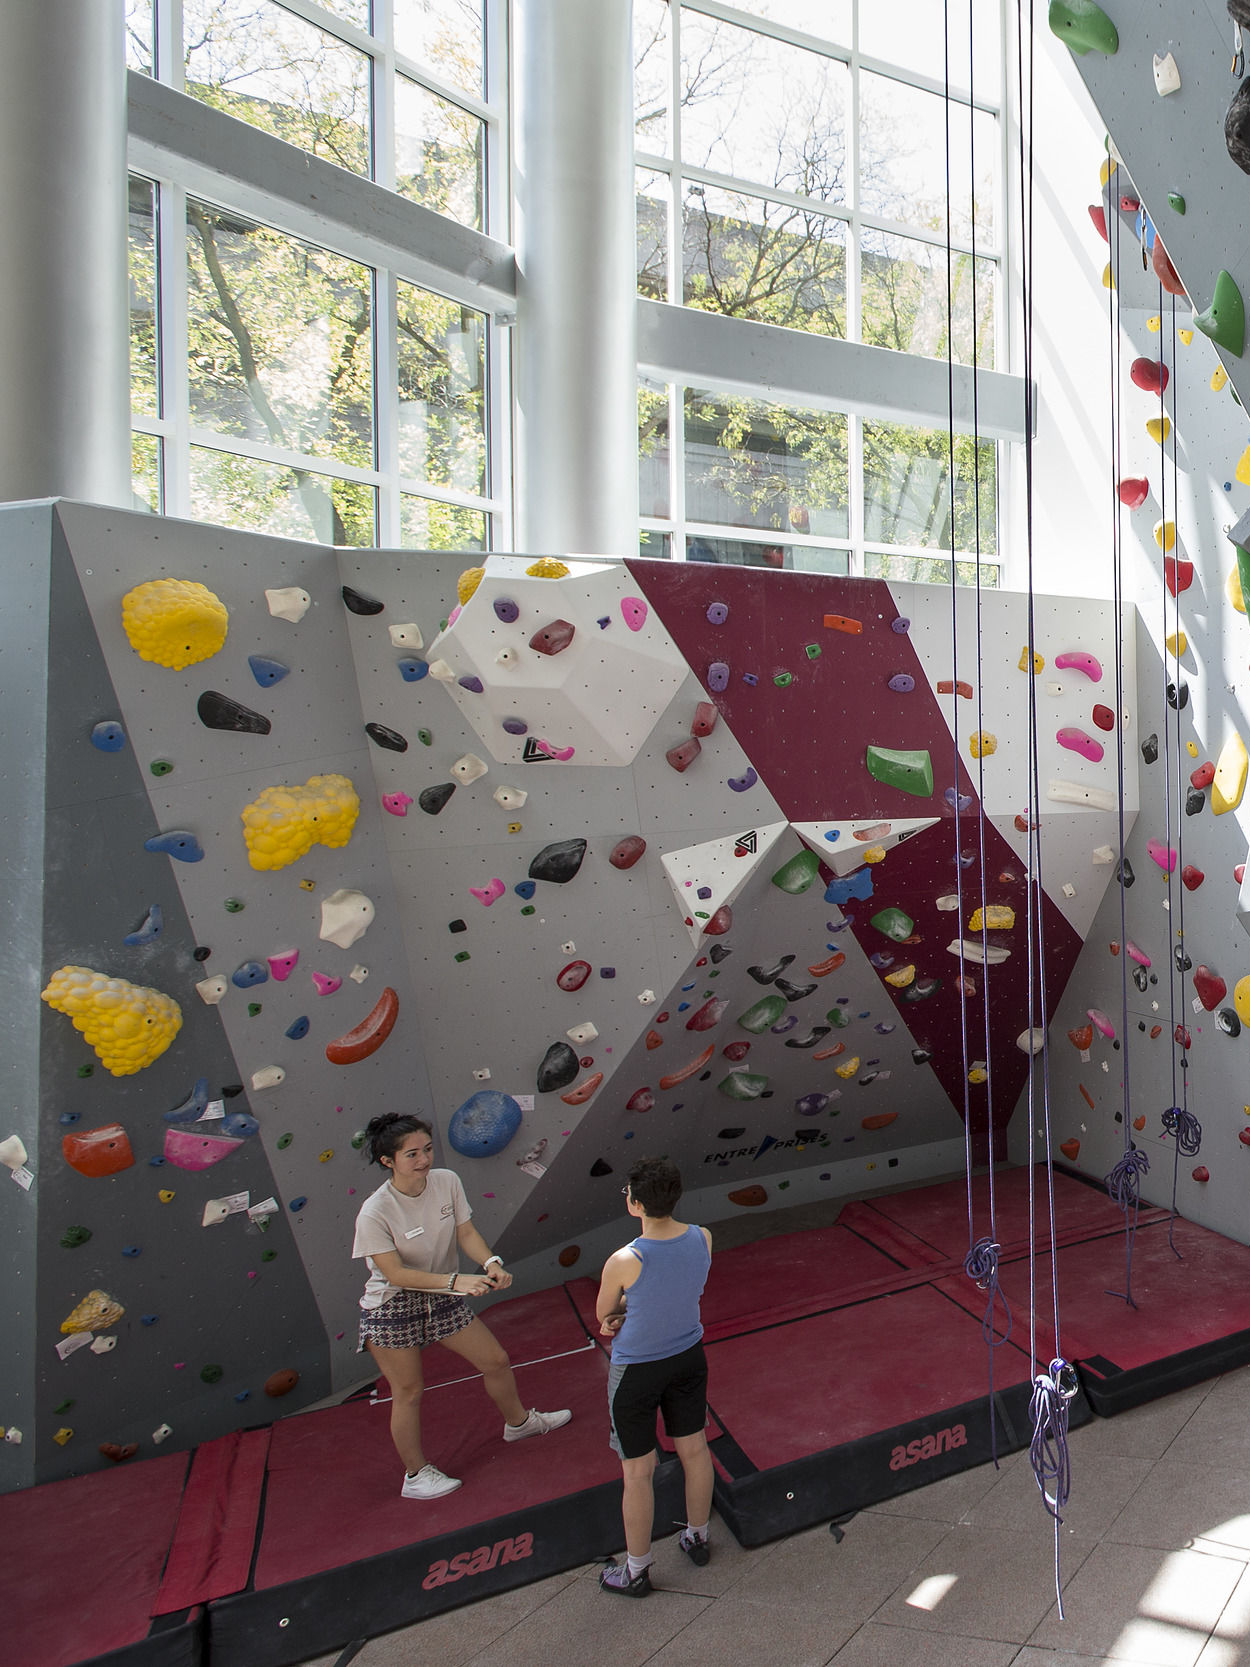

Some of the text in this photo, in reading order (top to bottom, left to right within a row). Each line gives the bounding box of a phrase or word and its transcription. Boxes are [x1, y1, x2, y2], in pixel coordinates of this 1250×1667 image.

[703, 1132, 829, 1164] ENTRE PRISES
[888, 1423, 968, 1472] asana
[421, 1531, 535, 1591] asana
